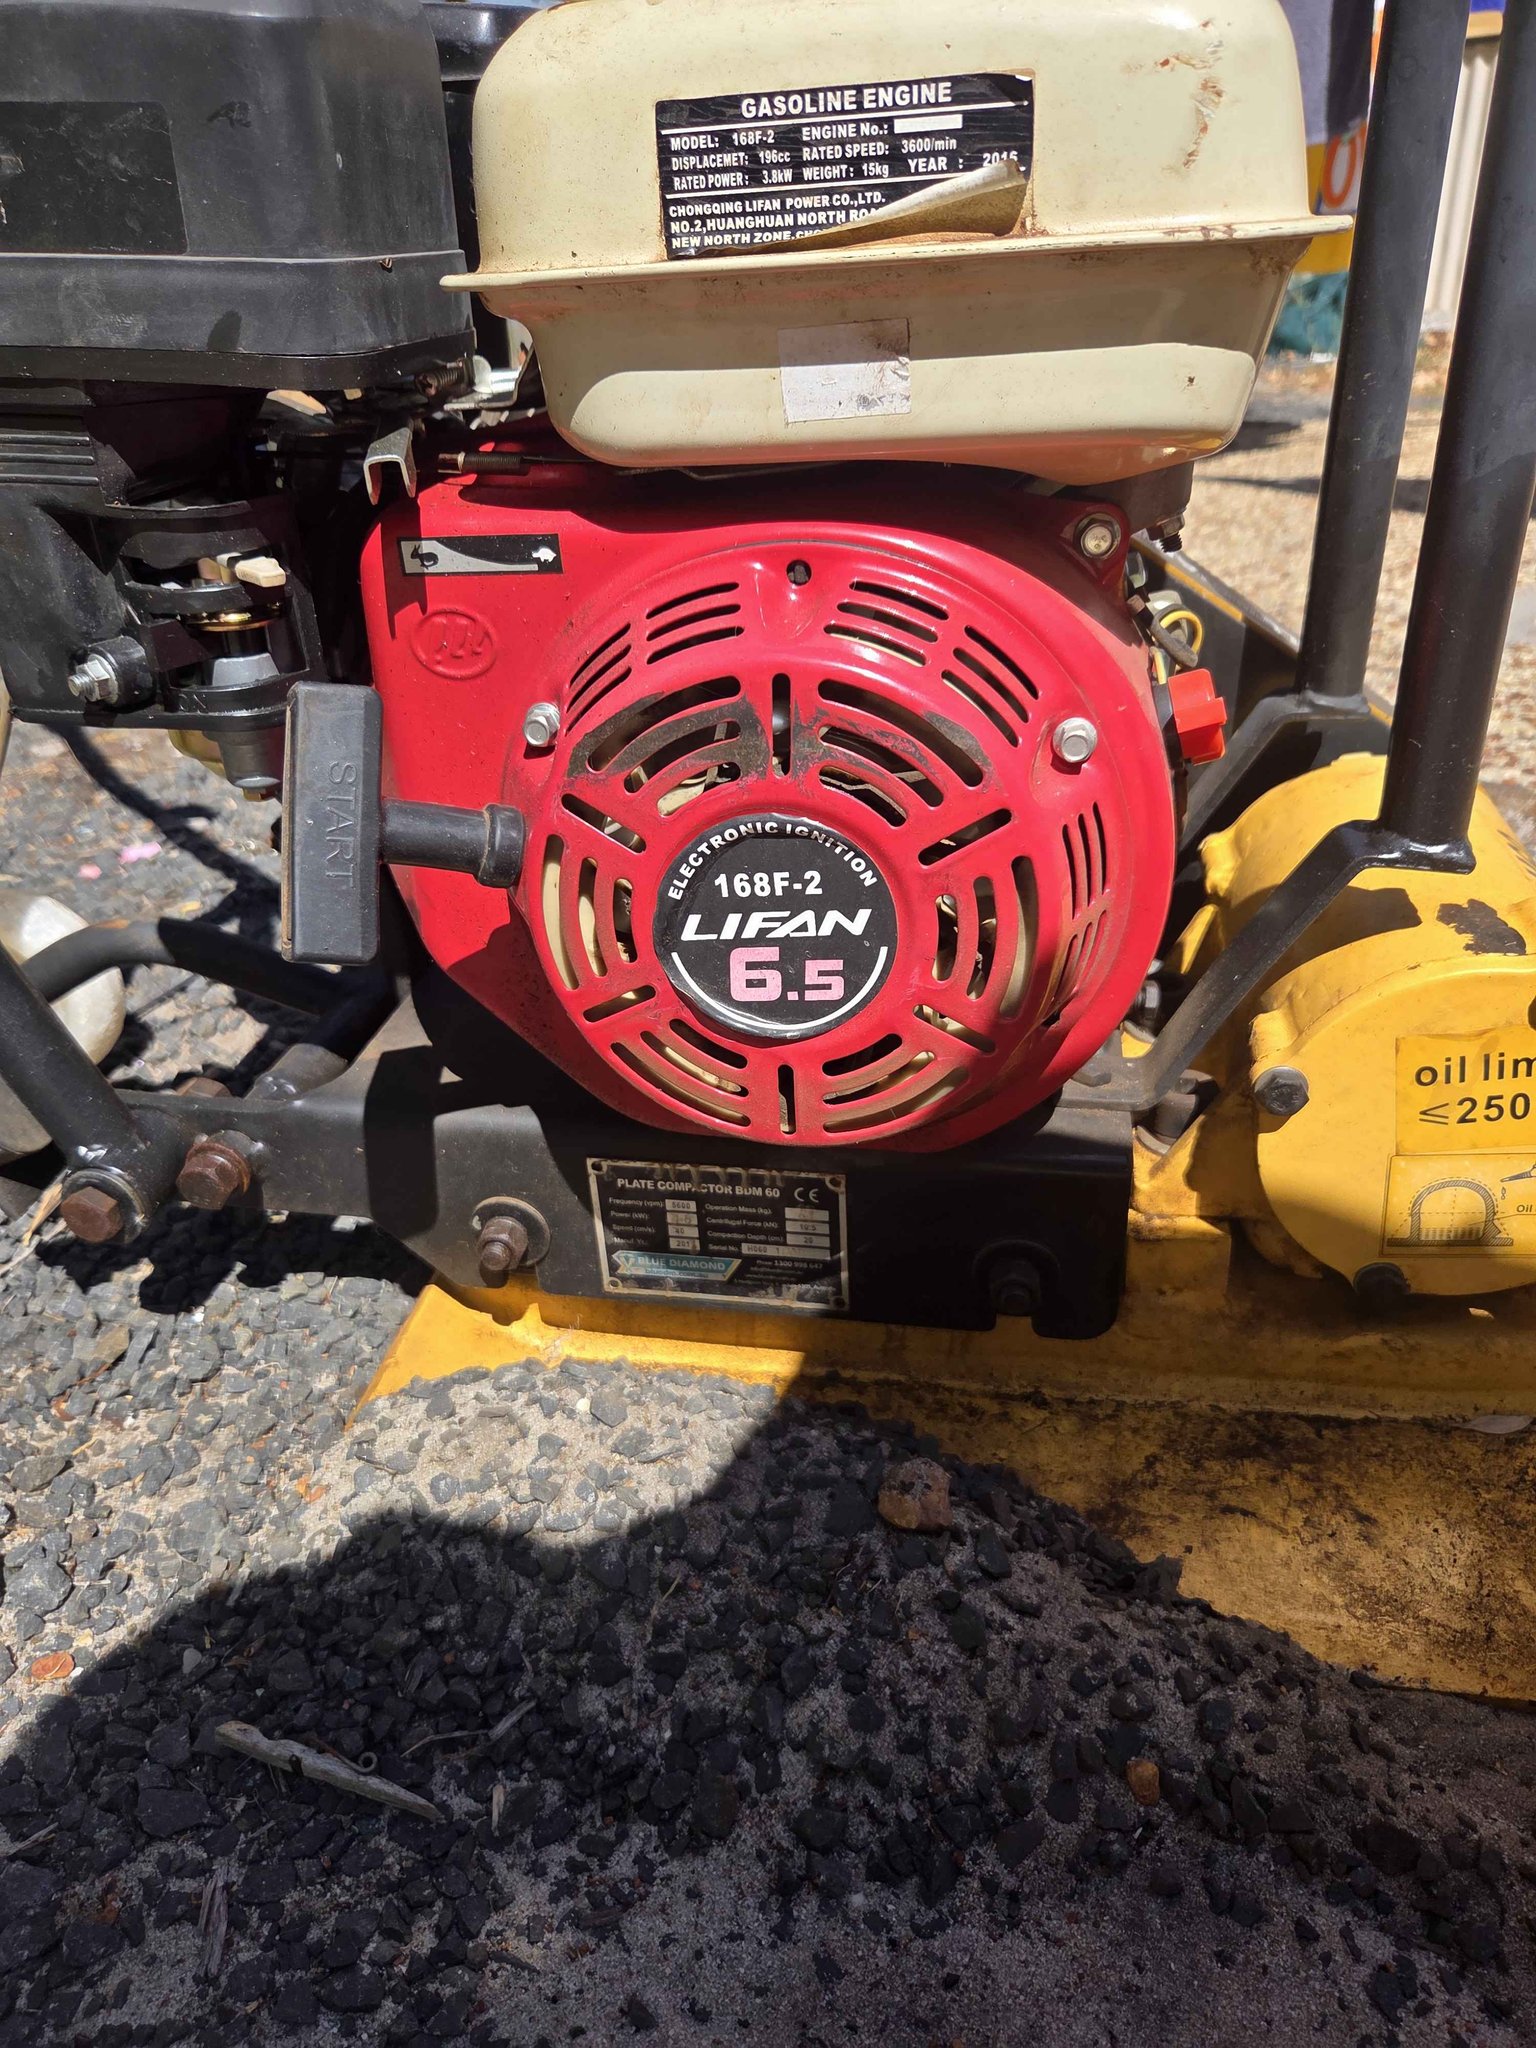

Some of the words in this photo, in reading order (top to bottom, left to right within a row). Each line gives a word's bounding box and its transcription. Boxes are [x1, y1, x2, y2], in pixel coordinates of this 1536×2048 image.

[741, 90, 857, 118] GASOLINE
[863, 82, 952, 109] ENGINE
[670, 134, 719, 151] MODEL:
[732, 129, 775, 146] 168F-2
[802, 123, 857, 141] ENGINE
[860, 122, 889, 136] No.:
[802, 145, 843, 161] RATED
[845, 141, 889, 158] SPEED:
[901, 136, 957, 154] 3600/min
[671, 152, 749, 171] DISPLACEMET:
[759, 149, 791, 164] 196cc
[862, 162, 889, 178] 15kg
[908, 156, 948, 173] YEAR
[673, 174, 707, 191] RATED
[762, 168, 793, 184] 3.8kW
[669, 201, 743, 218] CHONGQING
[745, 199, 781, 212] LIFAN
[785, 195, 830, 210] POWER
[670, 213, 794, 234] NO.2,HUANGHUAN
[797, 210, 846, 225] NORTH
[672, 235, 702, 249] NEW
[704, 233, 751, 247] NORTH
[326, 761, 358, 888] START
[668, 821, 779, 901] ELECTRONIC
[786, 823, 878, 887] IGNITION
[714, 870, 823, 898] 168F-2
[681, 908, 872, 941] LIFAN
[730, 946, 845, 1001] 6.5
[1415, 1055, 1466, 1087] oil
[616, 1178, 655, 1190] PLATE
[735, 1186, 763, 1198] BDM
[765, 1188, 780, 1199] 60
[1516, 1203, 1533, 1213] Oil
[637, 1255, 666, 1266] BLUE
[669, 1258, 726, 1271] DIAMOND
